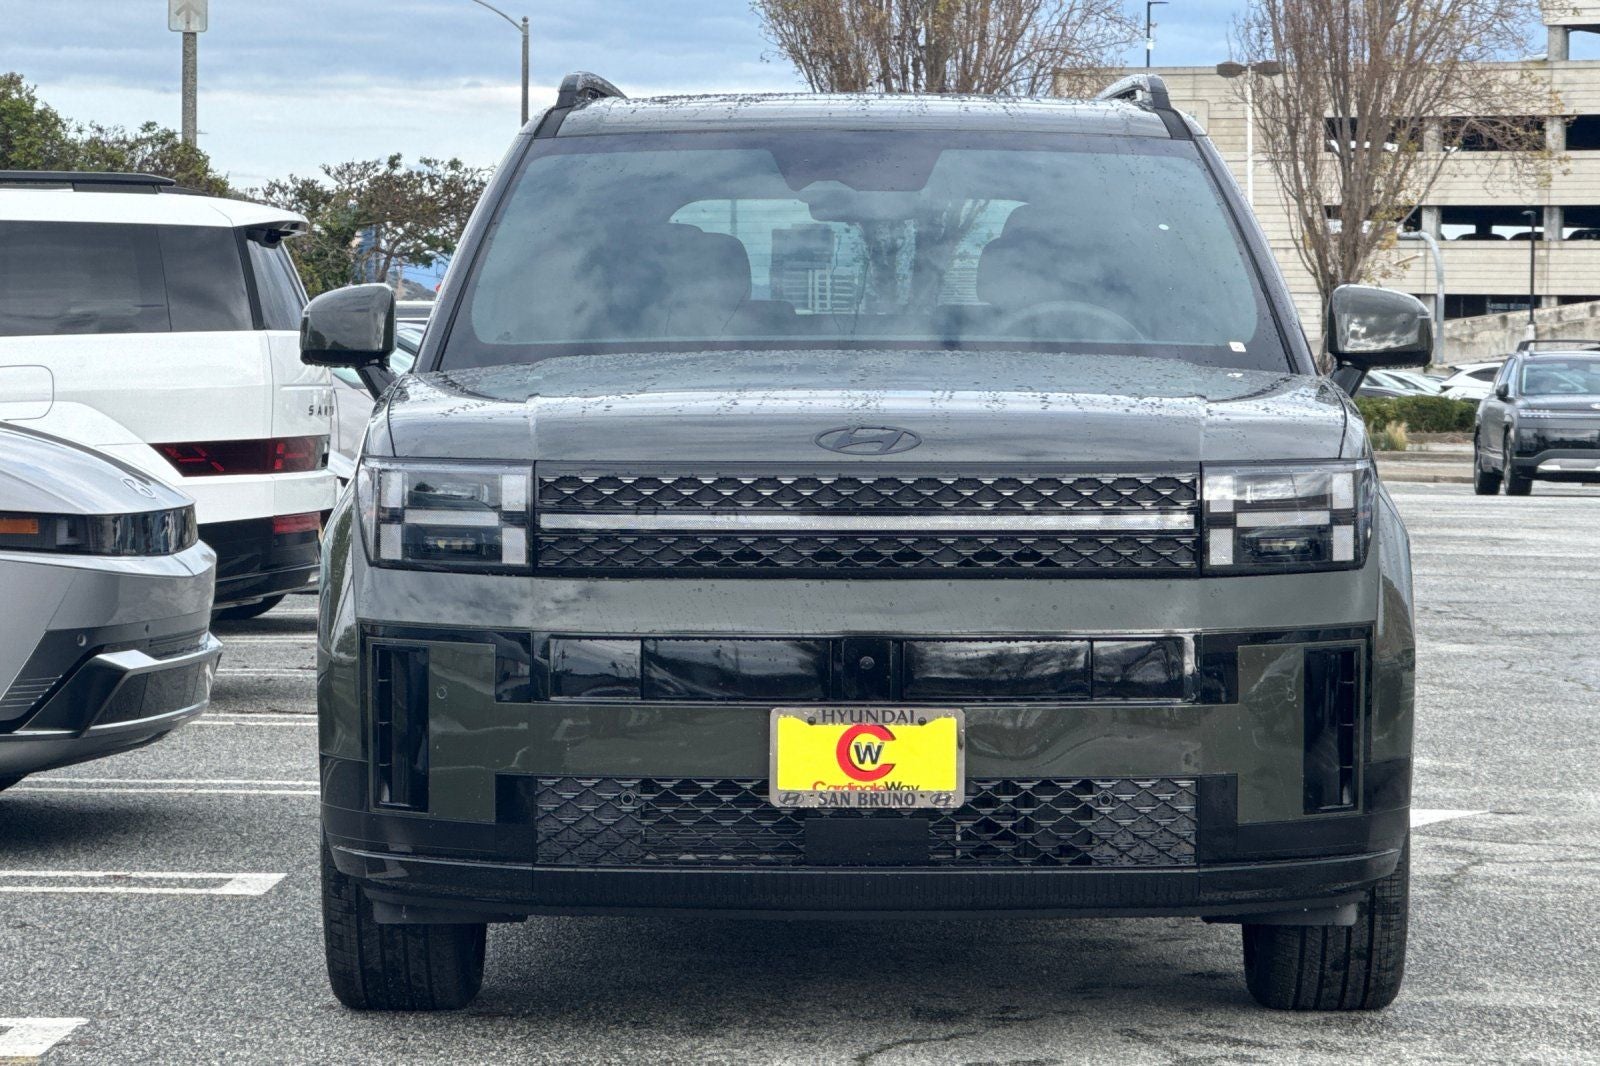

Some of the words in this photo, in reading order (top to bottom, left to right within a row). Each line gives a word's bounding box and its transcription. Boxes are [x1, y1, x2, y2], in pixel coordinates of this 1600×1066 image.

[822, 709, 915, 724] HYUNDAI
[818, 791, 851, 806] SAN
[857, 791, 916, 807] BRUNO
